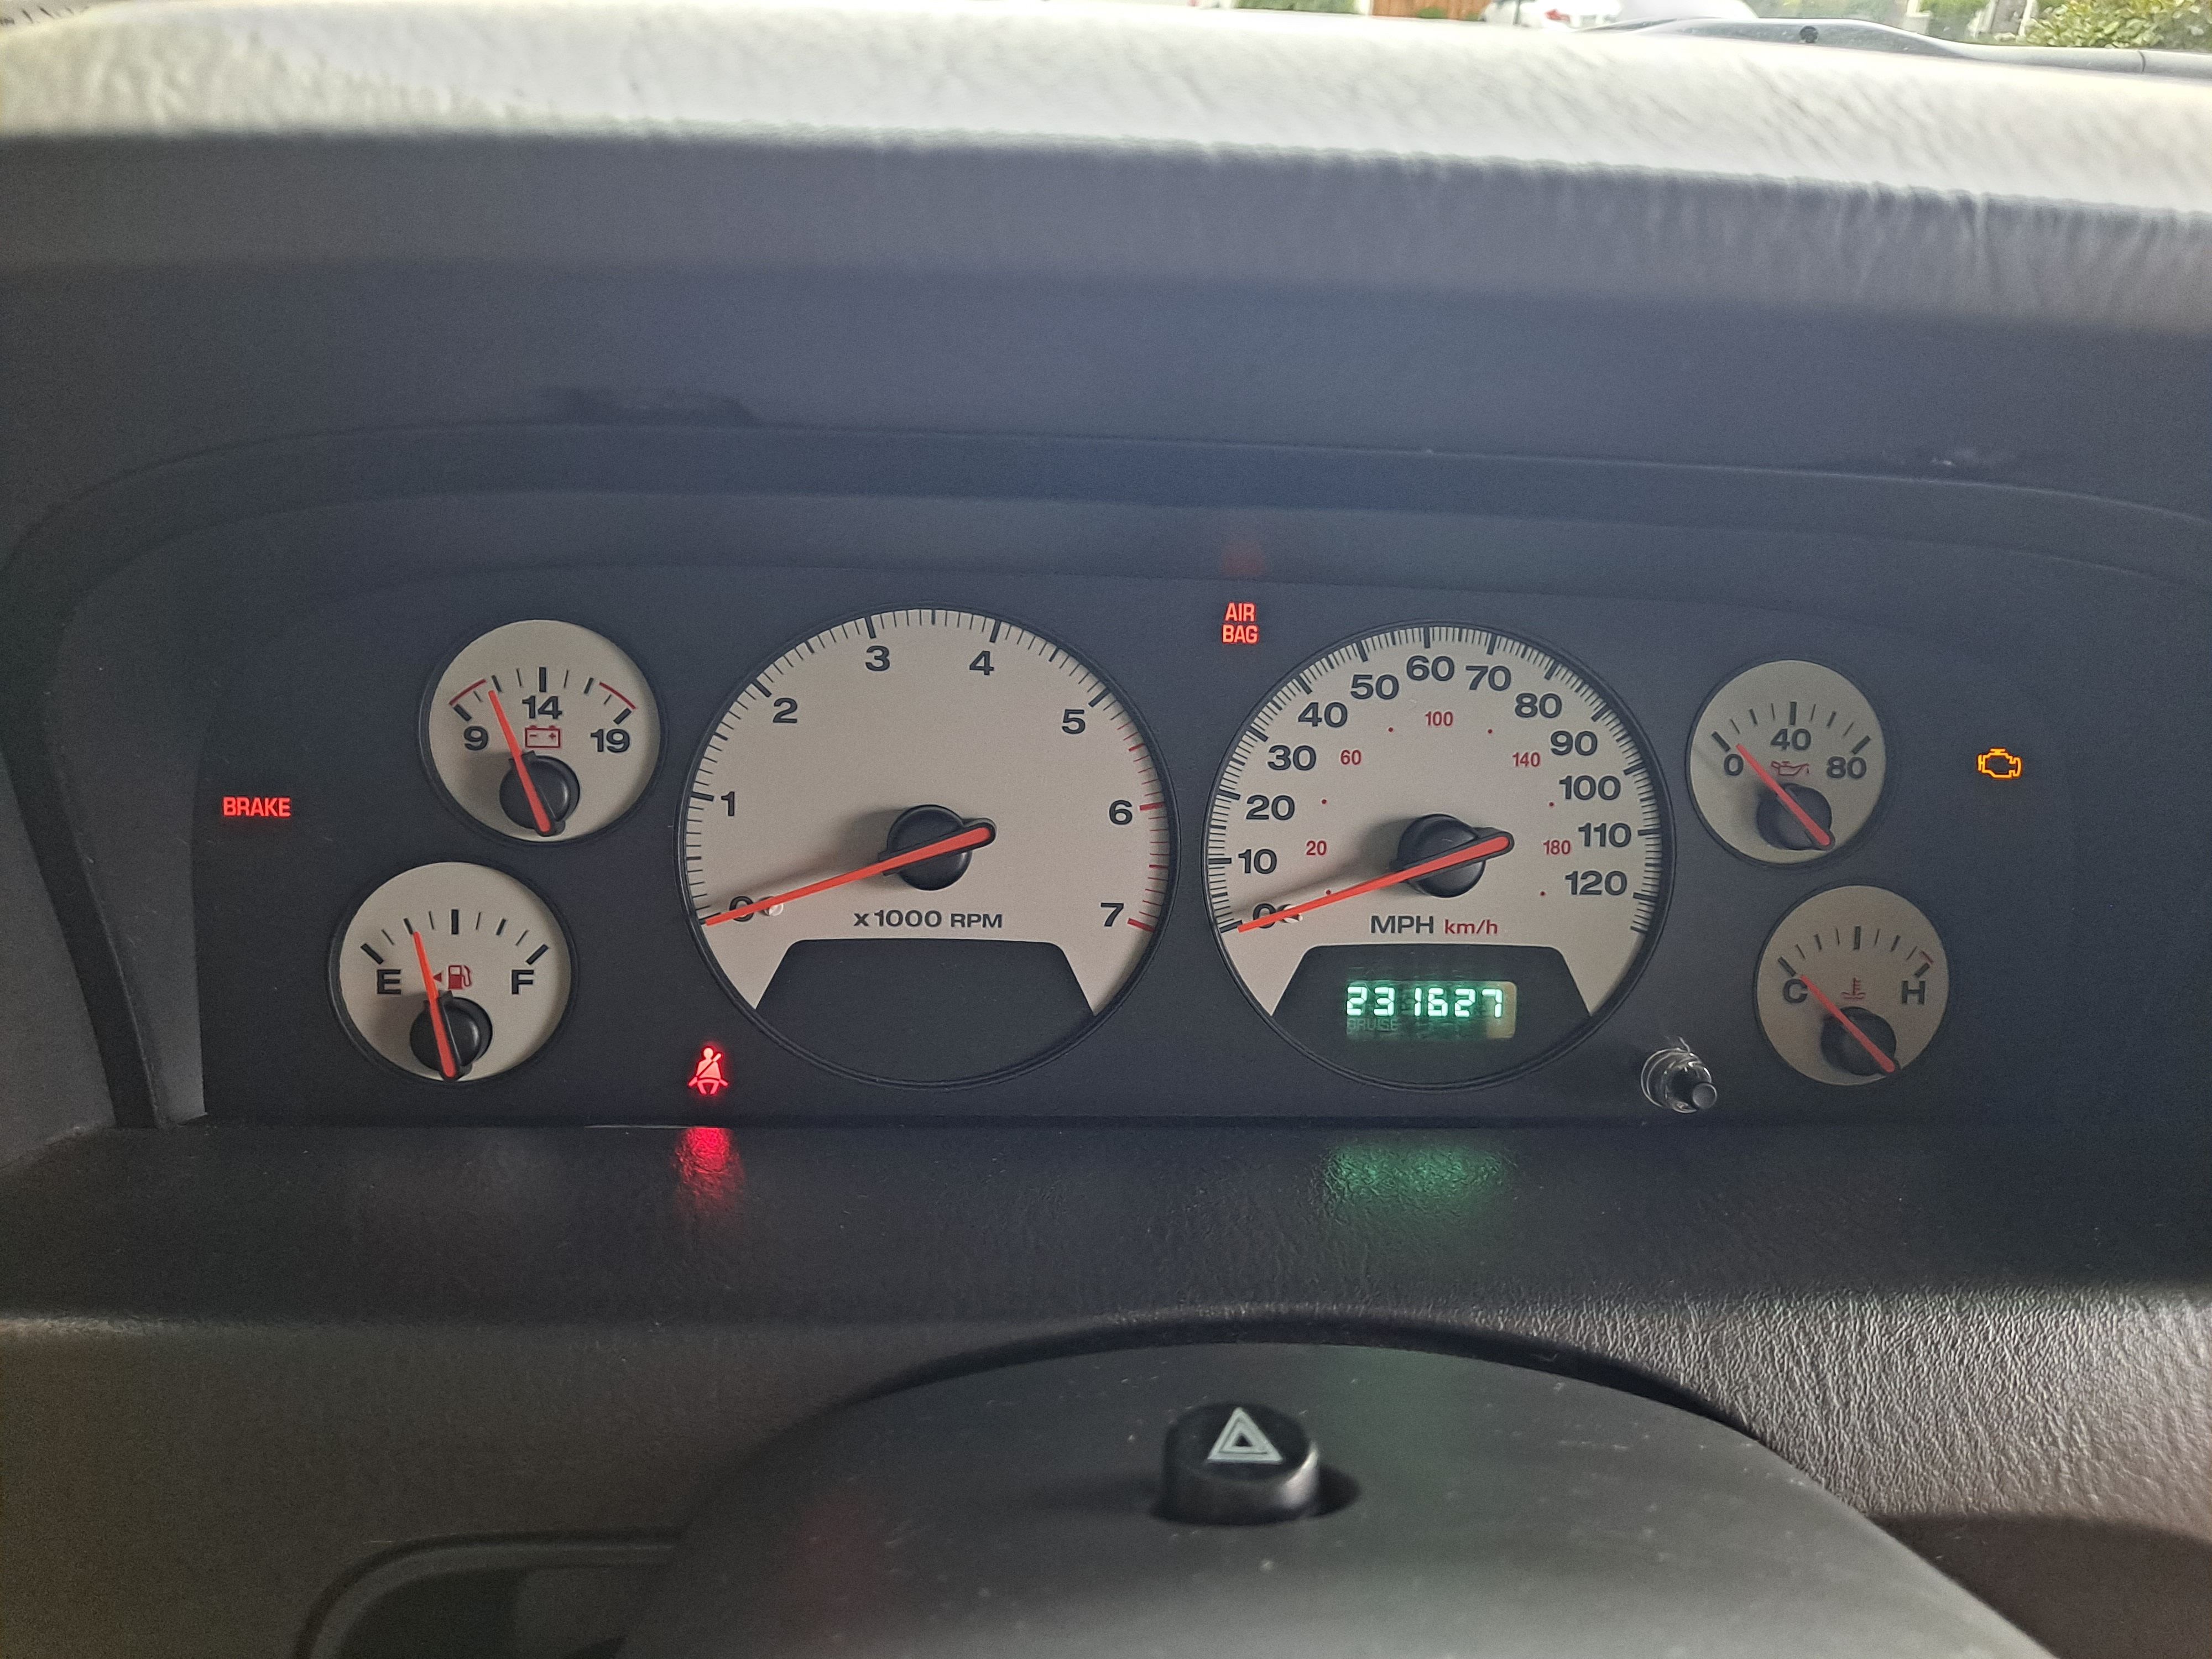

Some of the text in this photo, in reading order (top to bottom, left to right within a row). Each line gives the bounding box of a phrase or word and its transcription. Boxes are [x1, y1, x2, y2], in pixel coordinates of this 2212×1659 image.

[1225, 602, 1255, 622] AIR
[1222, 624, 1259, 644] BAG
[865, 645, 891, 672] 3
[969, 650, 994, 676] 4
[1406, 656, 1455, 681] 60
[1350, 675, 1399, 700] 50
[1466, 665, 1512, 691] 70
[522, 696, 562, 719] 14
[773, 698, 798, 724] 2
[1298, 702, 1348, 728] 40
[1515, 693, 1562, 718] 80
[1062, 709, 1086, 735] 5
[1426, 712, 1454, 727] 100
[463, 726, 488, 750] 9
[590, 729, 631, 753] 19
[1550, 731, 1598, 755] 90
[1771, 729, 1811, 751] 40
[1267, 745, 1317, 771] 30
[1340, 750, 1361, 765] 60
[1512, 753, 1541, 768] 140
[1723, 754, 1744, 776] 0
[1826, 757, 1867, 779] 80
[1559, 776, 1621, 800] 100
[222, 797, 291, 817] BRAKE
[721, 792, 735, 816] 1
[1109, 800, 1133, 825] 6
[1246, 795, 1295, 821] 20
[1578, 823, 1631, 847] 110
[1306, 841, 1327, 855] 20
[1543, 841, 1571, 855] 180
[1238, 849, 1277, 874] 10
[1564, 871, 1627, 896] 120
[728, 896, 754, 922] 0
[874, 910, 942, 928] 1000
[950, 914, 1003, 928] RPM
[1100, 903, 1125, 927] 7
[1253, 904, 1275, 928] 0
[1370, 916, 1498, 935] MPH km/h
[377, 969, 402, 995] E
[511, 969, 535, 994] F
[1783, 979, 1808, 1004] C
[1901, 980, 1926, 1005] H
[1346, 986, 1503, 1018] 231627
